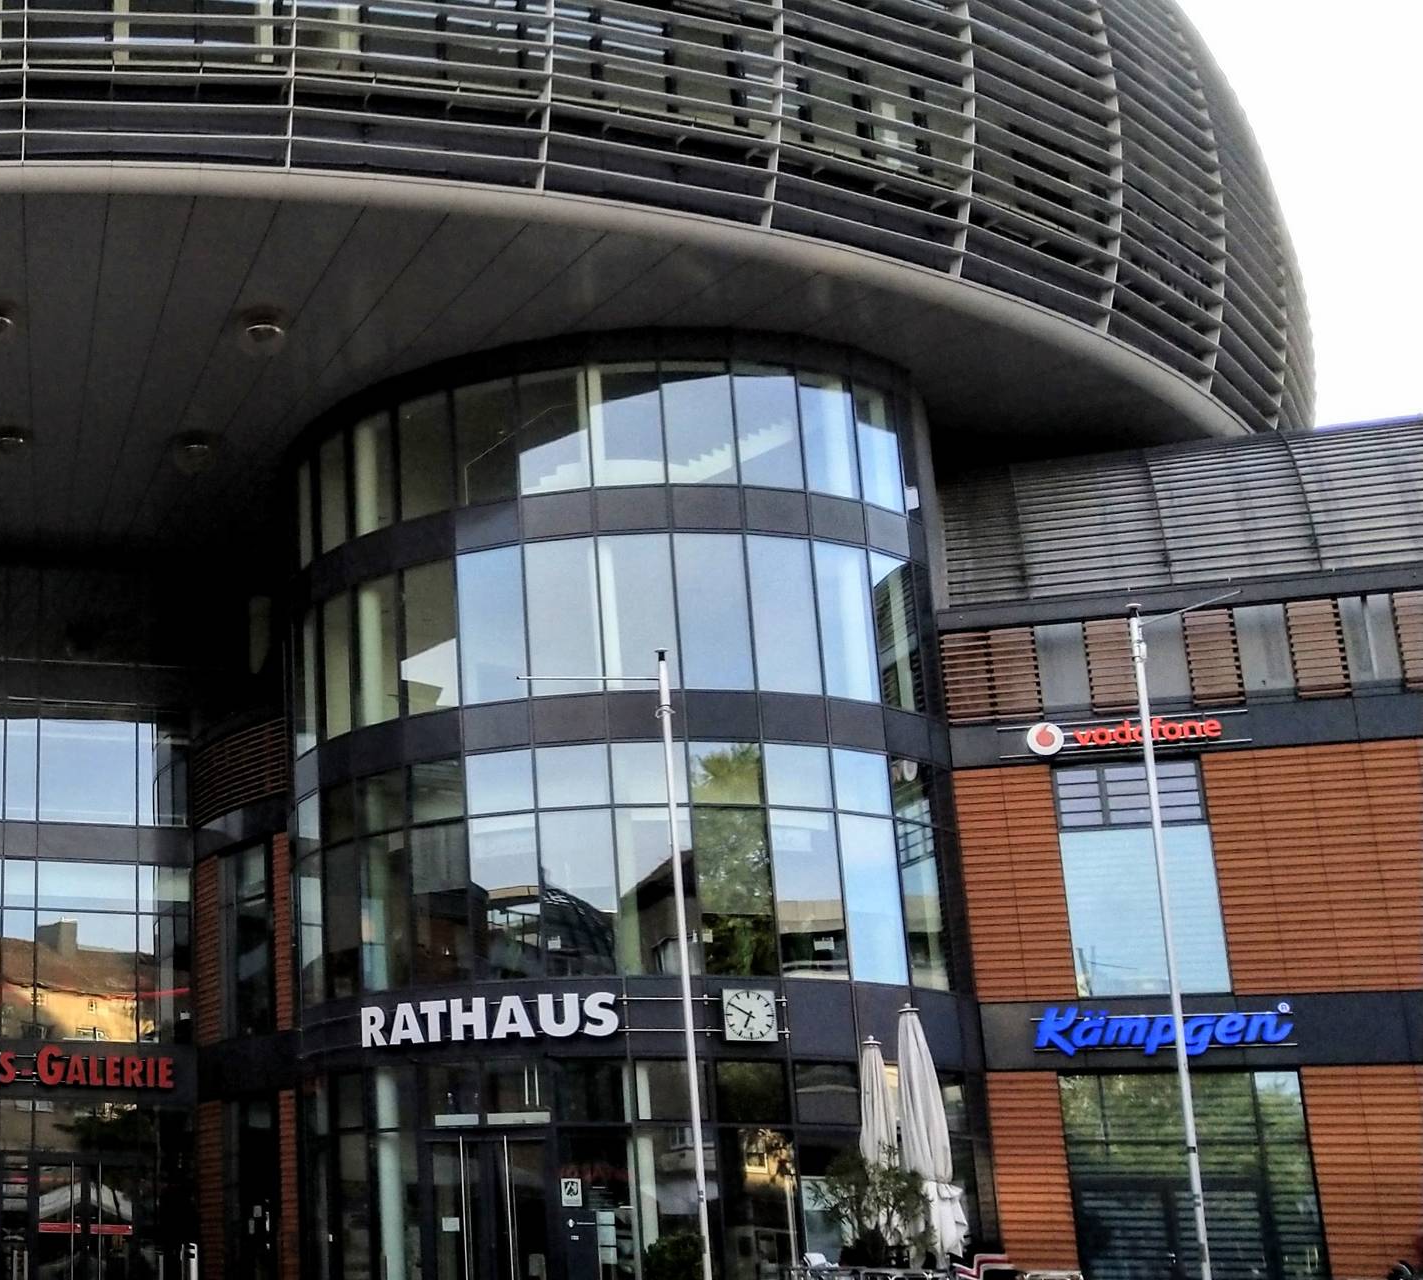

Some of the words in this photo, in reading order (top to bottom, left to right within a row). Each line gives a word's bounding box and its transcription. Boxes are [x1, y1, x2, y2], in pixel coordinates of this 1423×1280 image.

[1073, 718, 1222, 746] vodafone
[360, 991, 619, 1048] RATHAUS
[1034, 1006, 1294, 1056] Kämpgen
